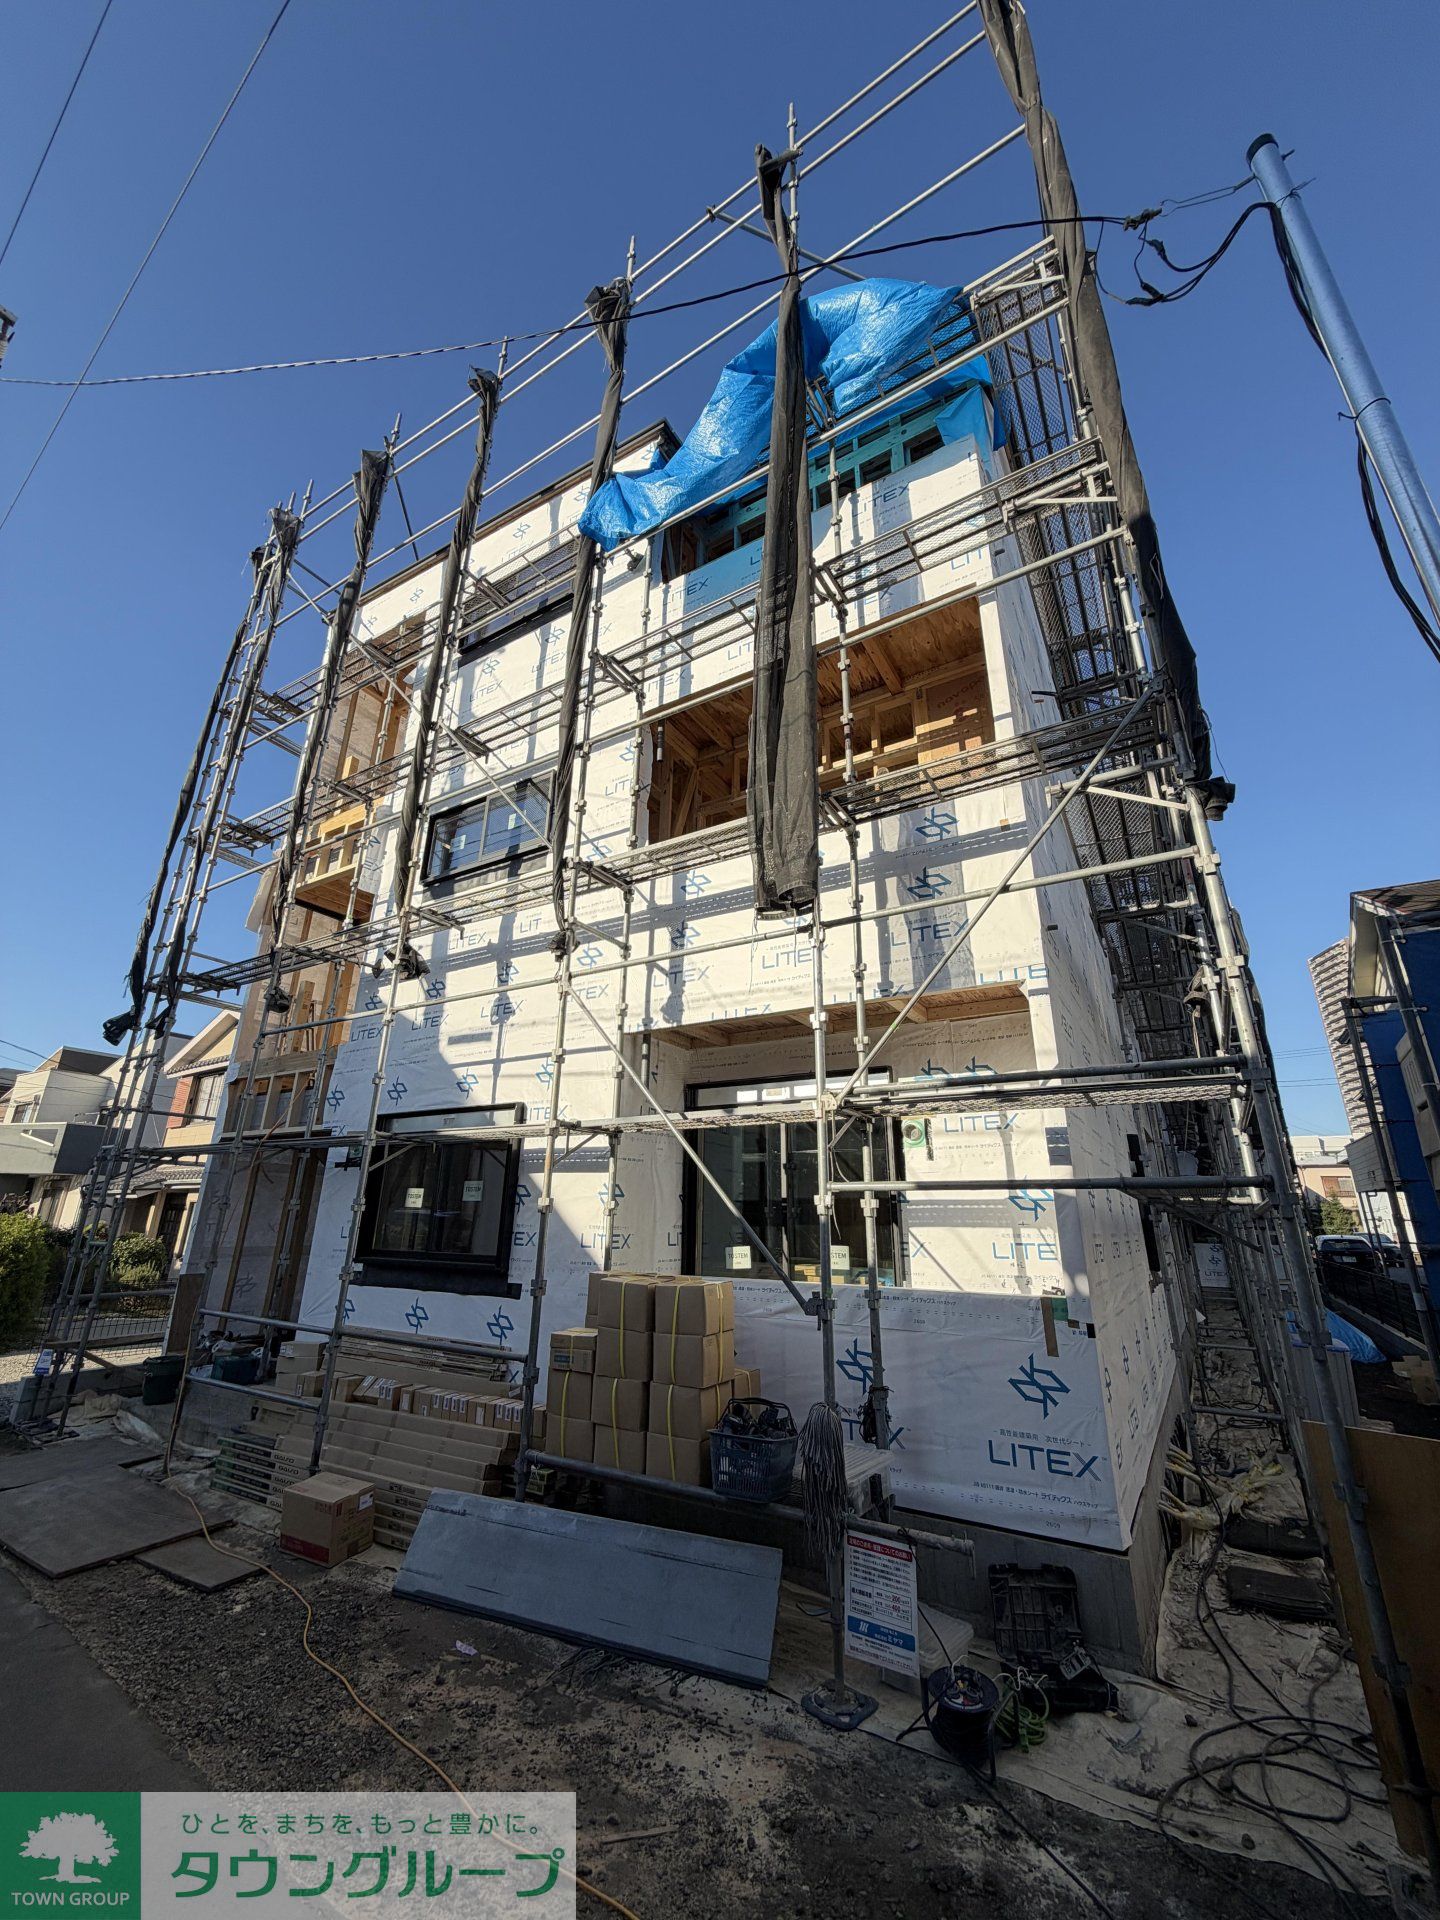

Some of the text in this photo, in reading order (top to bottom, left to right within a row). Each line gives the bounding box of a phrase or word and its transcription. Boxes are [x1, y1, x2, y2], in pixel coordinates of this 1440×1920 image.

[944, 1112, 1021, 1134] LITEX
[727, 1252, 749, 1260] TOSTEM
[831, 1252, 848, 1260] STEM
[992, 1241, 1058, 1261] LITE
[988, 1440, 1102, 1482] LITEX
